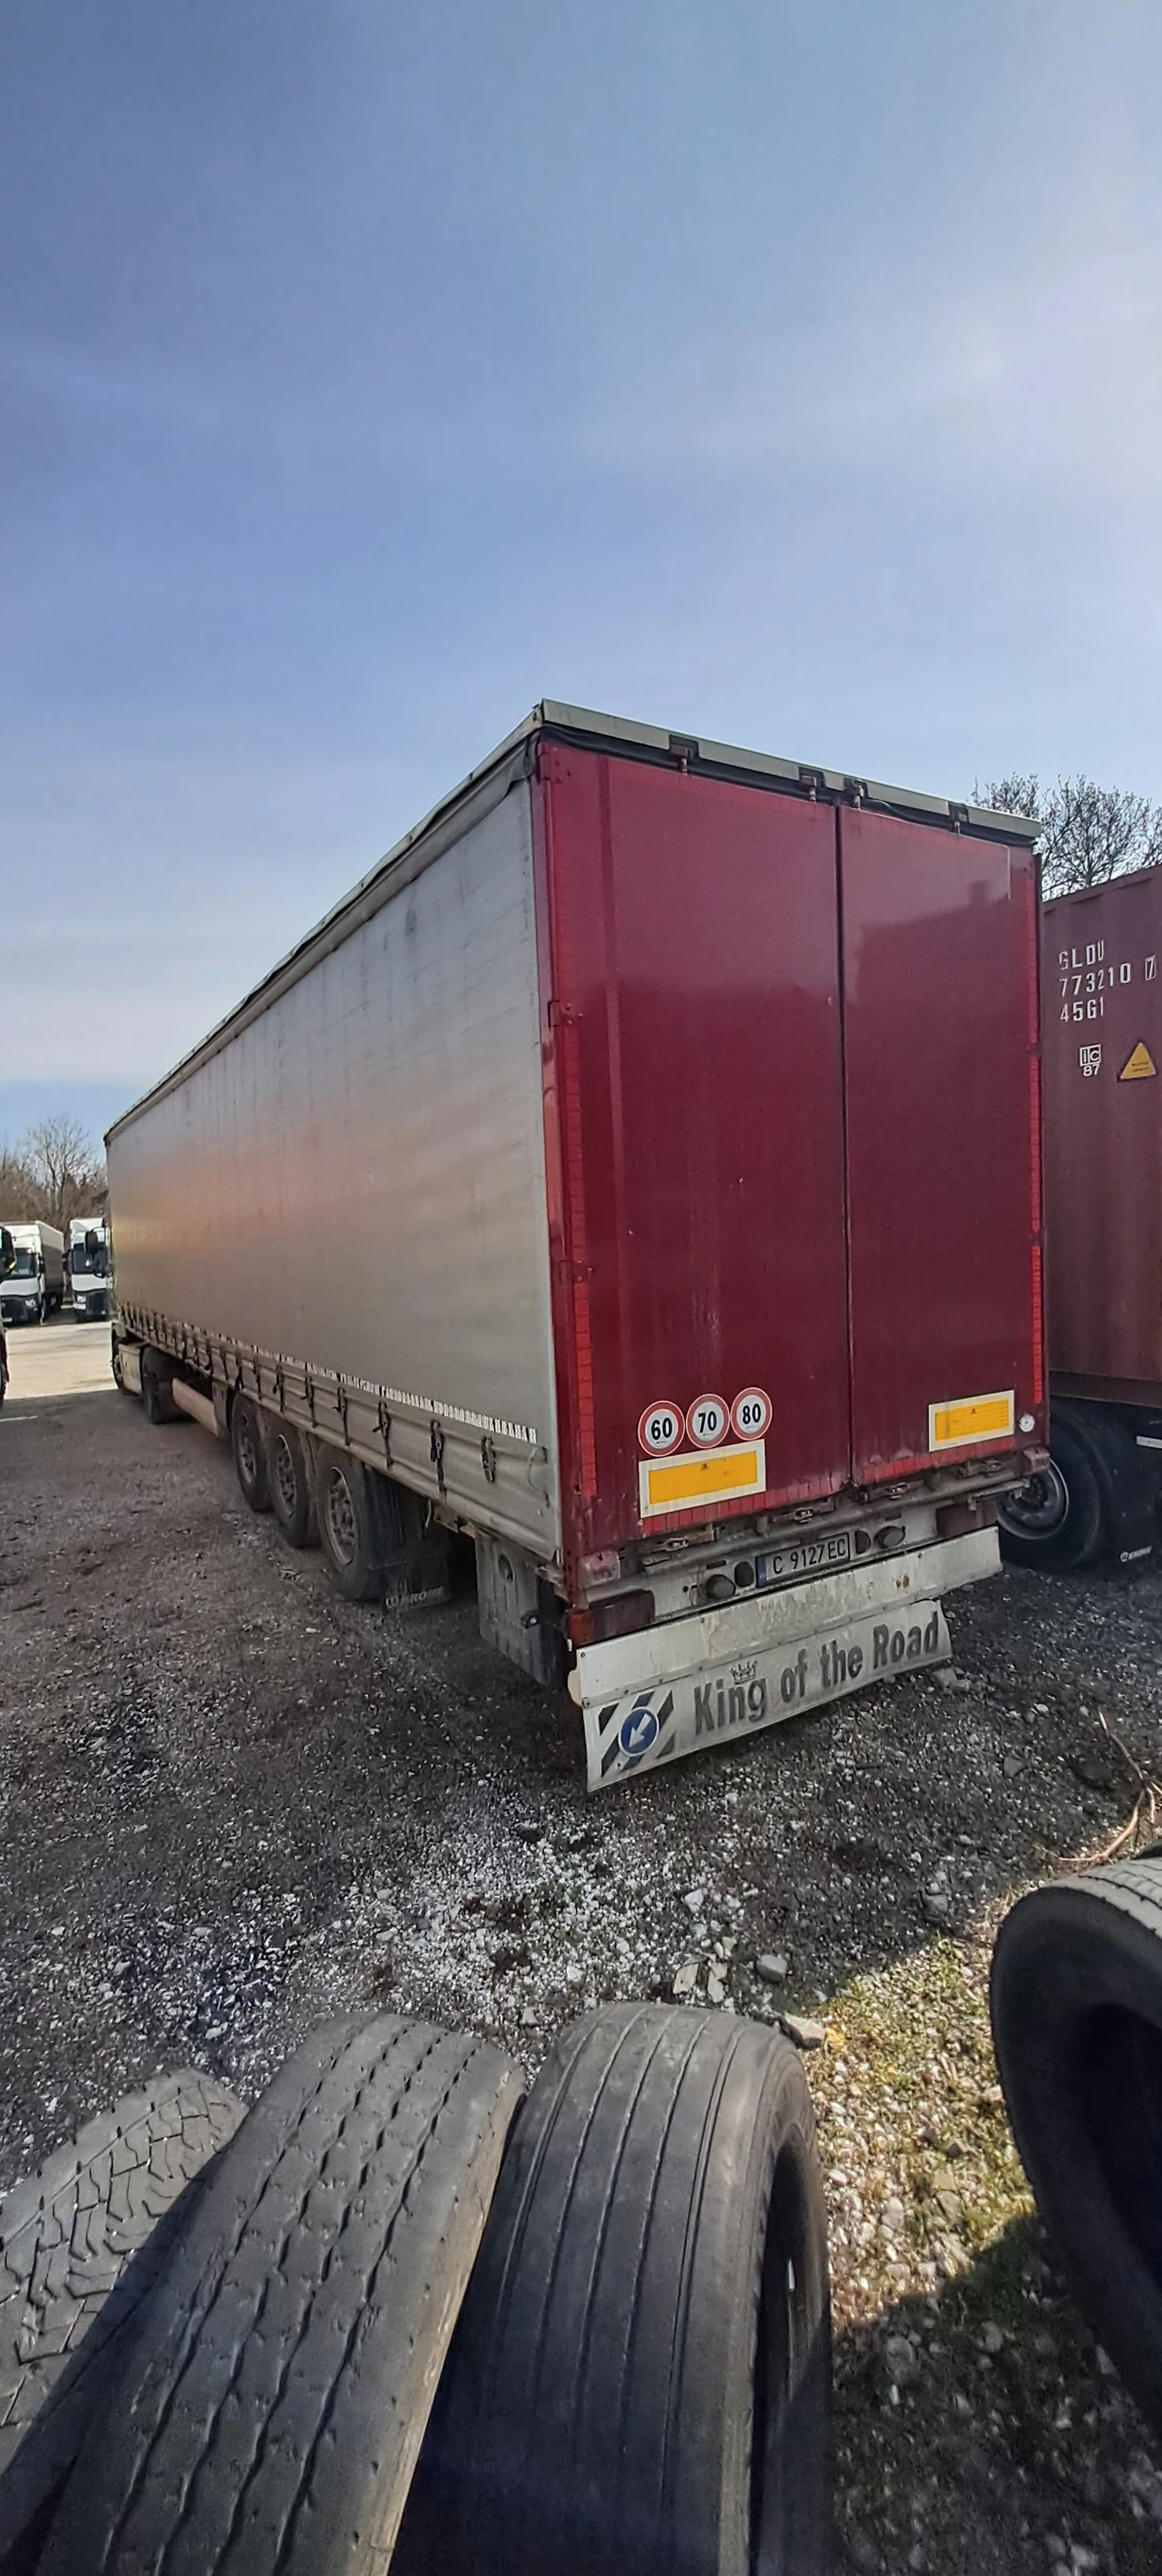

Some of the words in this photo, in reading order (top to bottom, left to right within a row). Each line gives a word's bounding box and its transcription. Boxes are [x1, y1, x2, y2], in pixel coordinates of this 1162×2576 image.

[1059, 963, 1131, 997] 773210
[1059, 996, 1104, 1022] 45G1
[1083, 1064, 1100, 1076] 87
[698, 1410, 717, 1433] 70
[742, 1403, 761, 1425] 80
[651, 1417, 673, 1440] 60
[773, 1556, 783, 1574] C
[694, 1678, 767, 1735] King
[781, 1649, 809, 1703] of
[820, 1640, 863, 1687] the
[873, 1611, 939, 1669] Road
